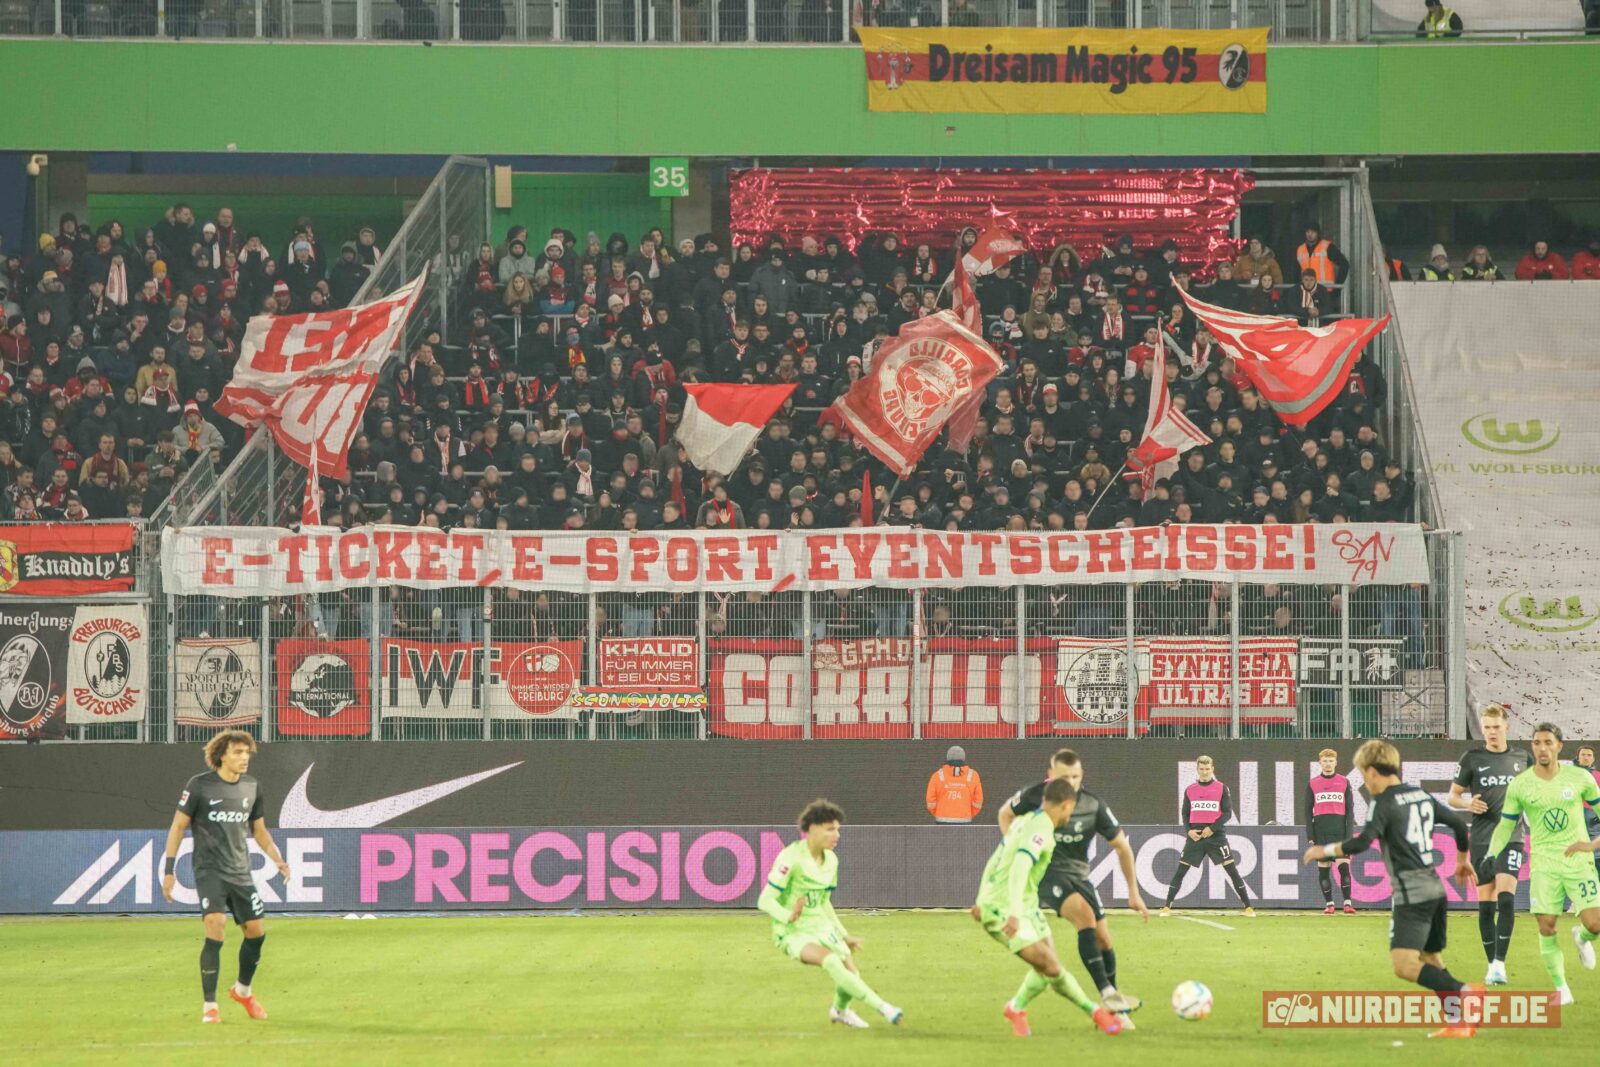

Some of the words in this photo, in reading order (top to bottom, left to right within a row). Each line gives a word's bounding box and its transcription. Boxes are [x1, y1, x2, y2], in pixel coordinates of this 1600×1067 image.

[929, 43, 1057, 84] Dreisam
[1064, 44, 1152, 94] Magic
[1162, 46, 1198, 84] 95
[653, 166, 686, 188] 35
[1331, 529, 1395, 562] SYN
[24, 552, 130, 580] Knaddly's
[1346, 559, 1377, 581] 79
[72, 618, 141, 643] FREIBURGER
[605, 643, 692, 656] KHALID
[605, 658, 637, 671] FÜR
[642, 661, 693, 670] IMMER
[1152, 654, 1293, 678] SYNTHESIA
[618, 673, 641, 682] BEI
[646, 673, 681, 682] UNS
[295, 692, 350, 700] INTERNATIONAL
[518, 691, 564, 701] FREIBURG
[723, 653, 1042, 725] CORRILLO
[1157, 682, 1251, 704] ULTRAS
[1260, 682, 1289, 704] 79
[73, 687, 141, 716] BOTSCHAFT
[1480, 776, 1517, 786] CAZO
[208, 811, 249, 822] CAZOO
[1406, 801, 1434, 853] 42
[1220, 845, 1231, 858] 17
[1579, 880, 1598, 898] 33
